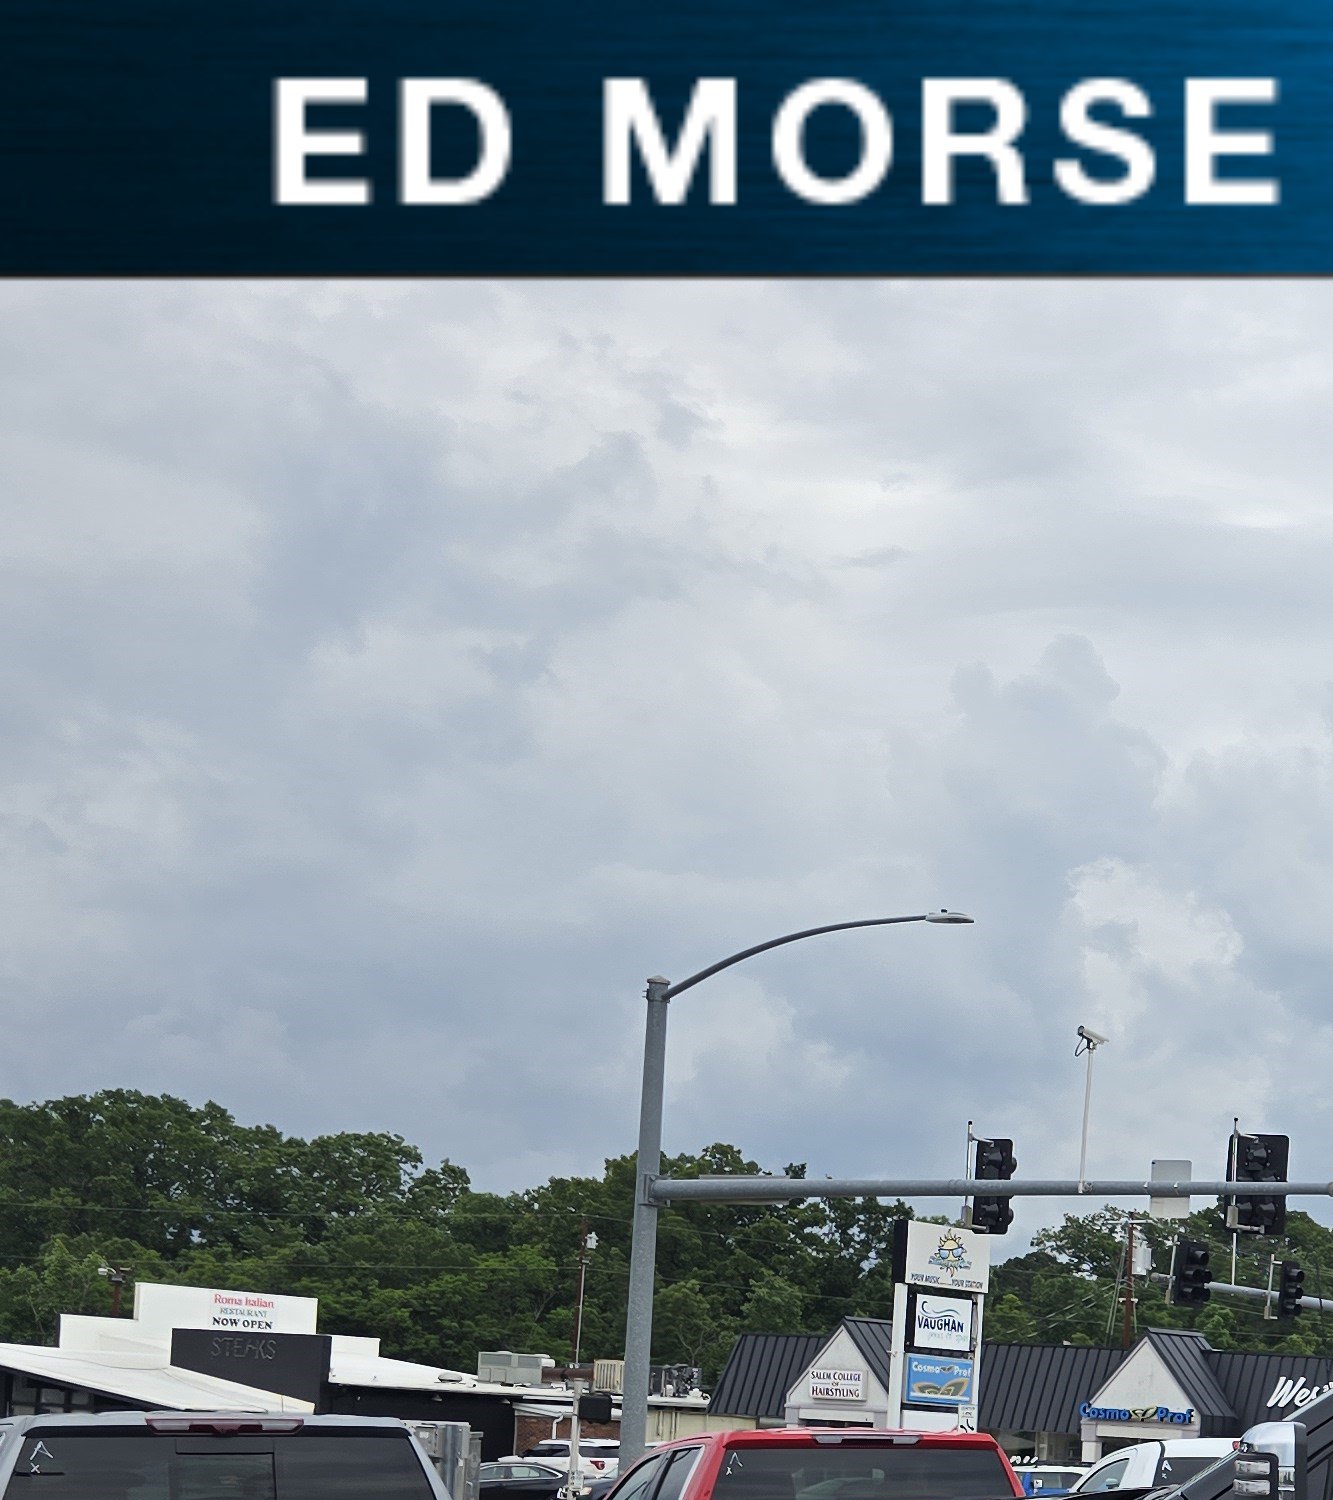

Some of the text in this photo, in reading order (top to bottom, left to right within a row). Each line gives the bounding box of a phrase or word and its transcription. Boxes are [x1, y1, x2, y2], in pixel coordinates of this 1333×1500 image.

[214, 1293, 274, 1309] Roma Italian
[212, 1317, 273, 1330] NOW OPEN
[918, 1315, 964, 1333] VAUGHAN
[811, 1371, 861, 1381] SALEM COLLEGE
[912, 1361, 972, 1377] Cosmo Prof
[811, 1385, 860, 1398] HAIRSTYLING
[1079, 1402, 1195, 1425] Cosmo Prof
